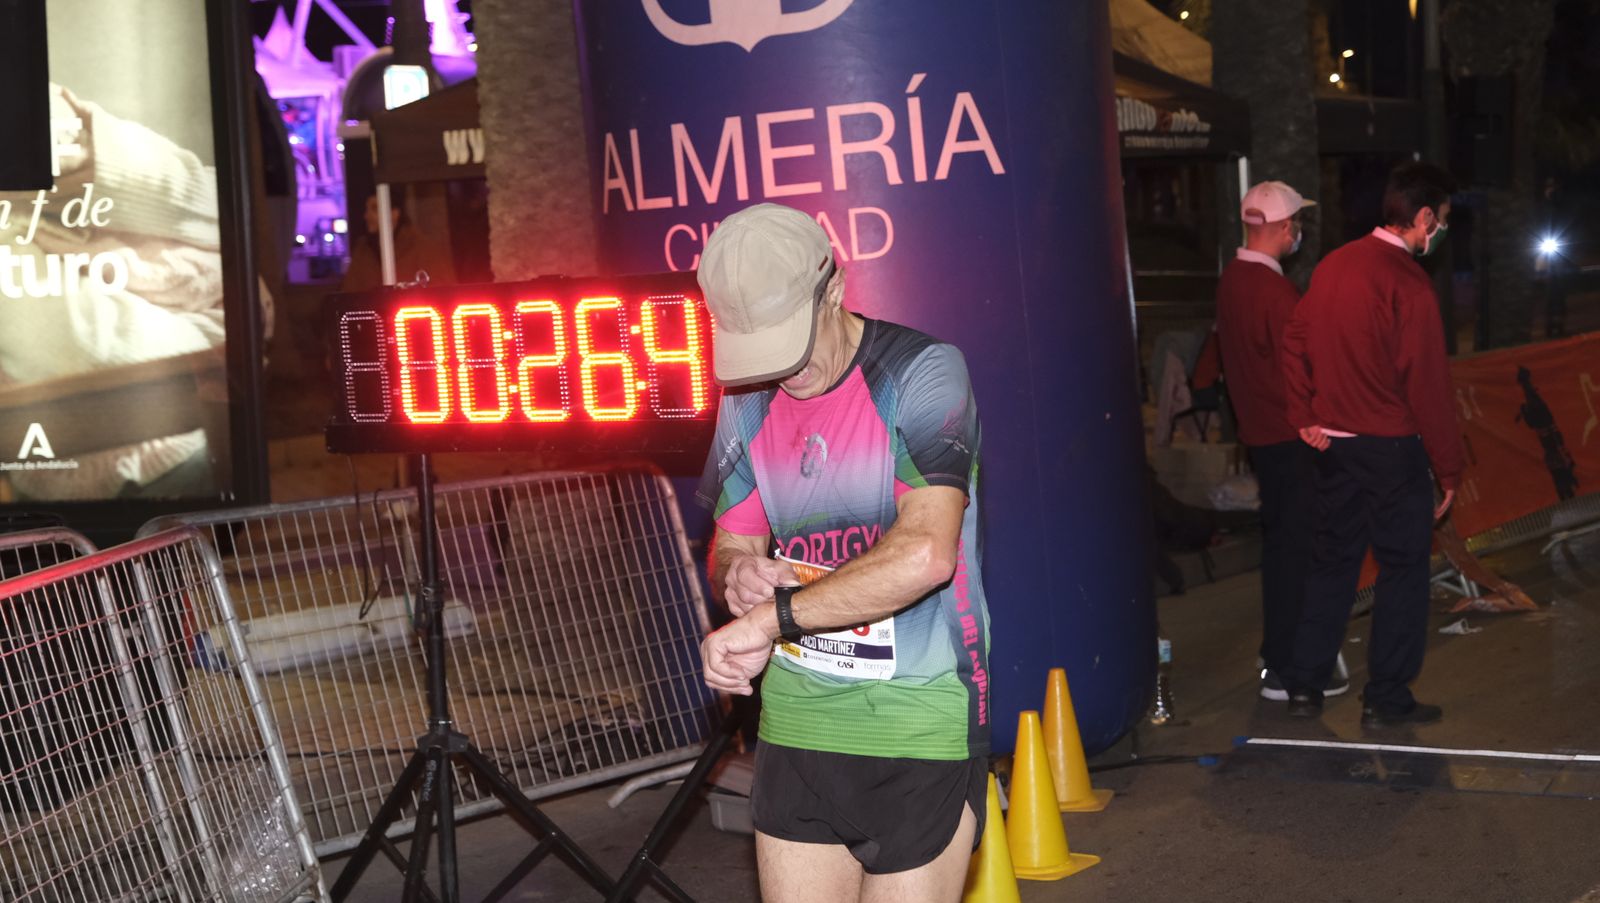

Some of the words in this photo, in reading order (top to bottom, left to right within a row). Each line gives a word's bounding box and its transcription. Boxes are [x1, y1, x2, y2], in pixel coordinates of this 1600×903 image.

[602, 73, 1006, 214] ALMERÍA
[61, 183, 114, 228] de
[664, 207, 894, 272] CIAD
